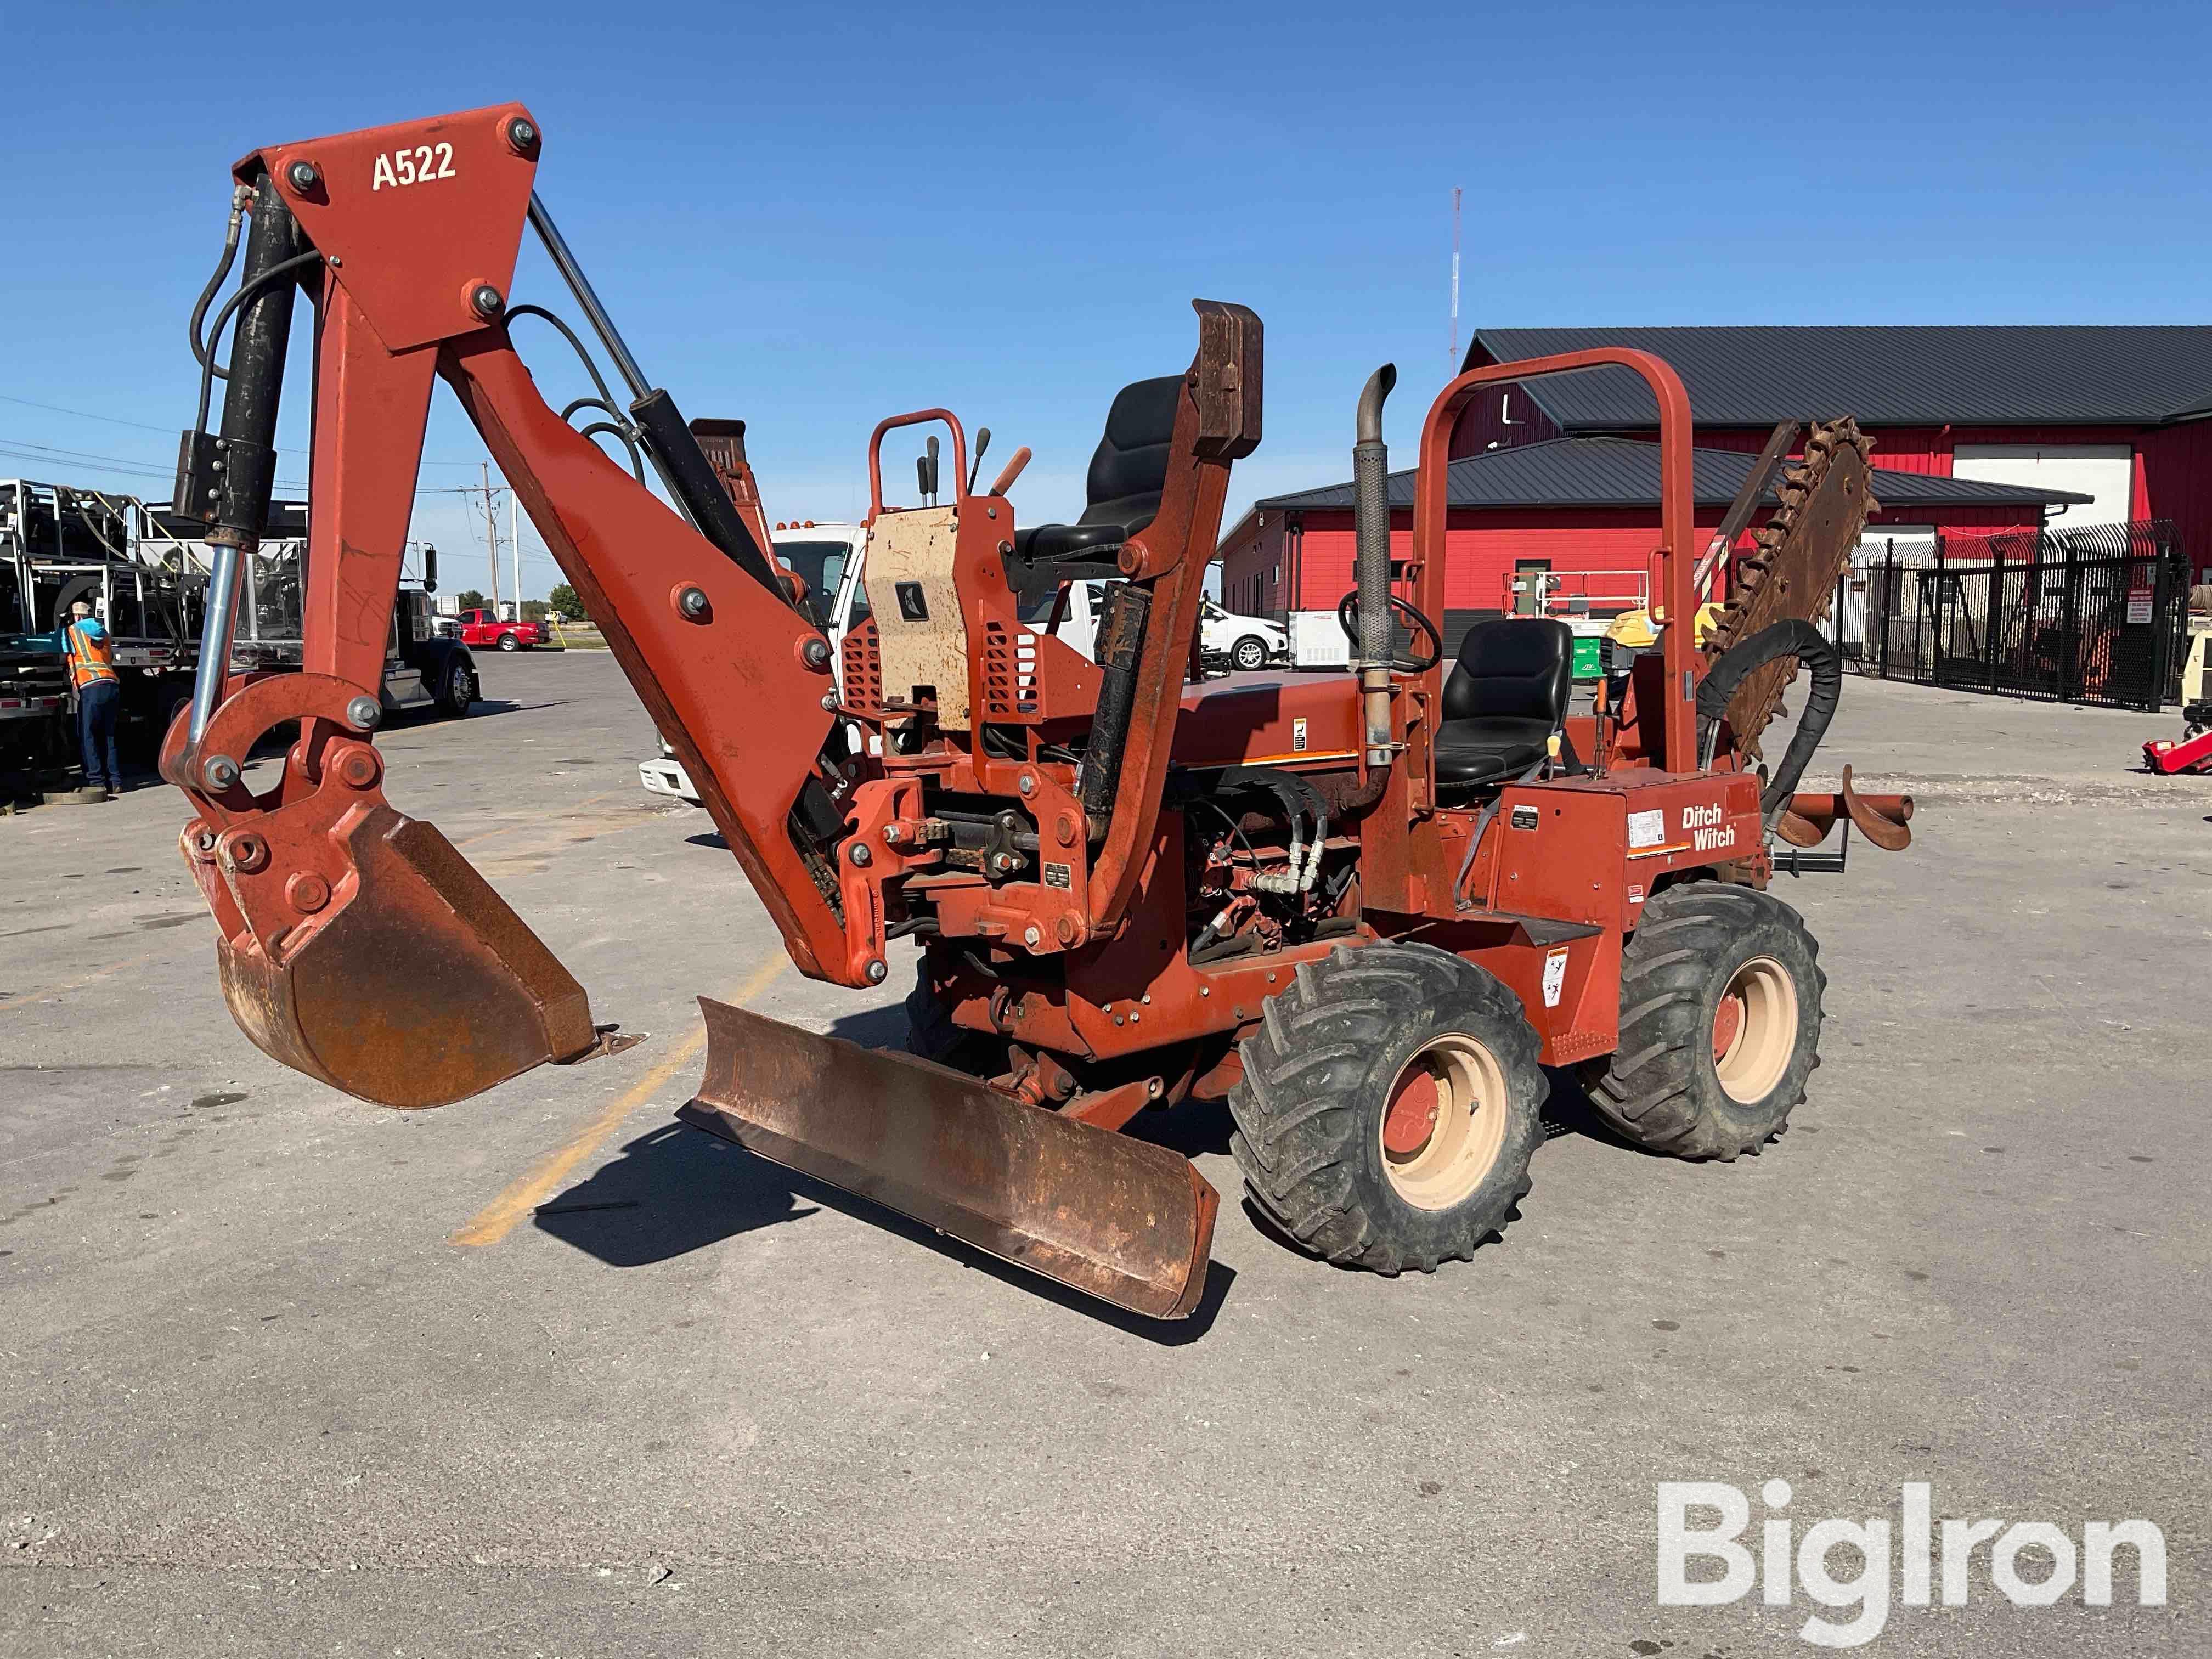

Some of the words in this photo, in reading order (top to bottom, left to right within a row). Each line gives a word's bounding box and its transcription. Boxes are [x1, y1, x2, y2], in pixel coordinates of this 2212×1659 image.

[373, 142, 456, 190] A522
[1683, 803, 1722, 830] Ditch
[1694, 825, 1735, 851] Witch
